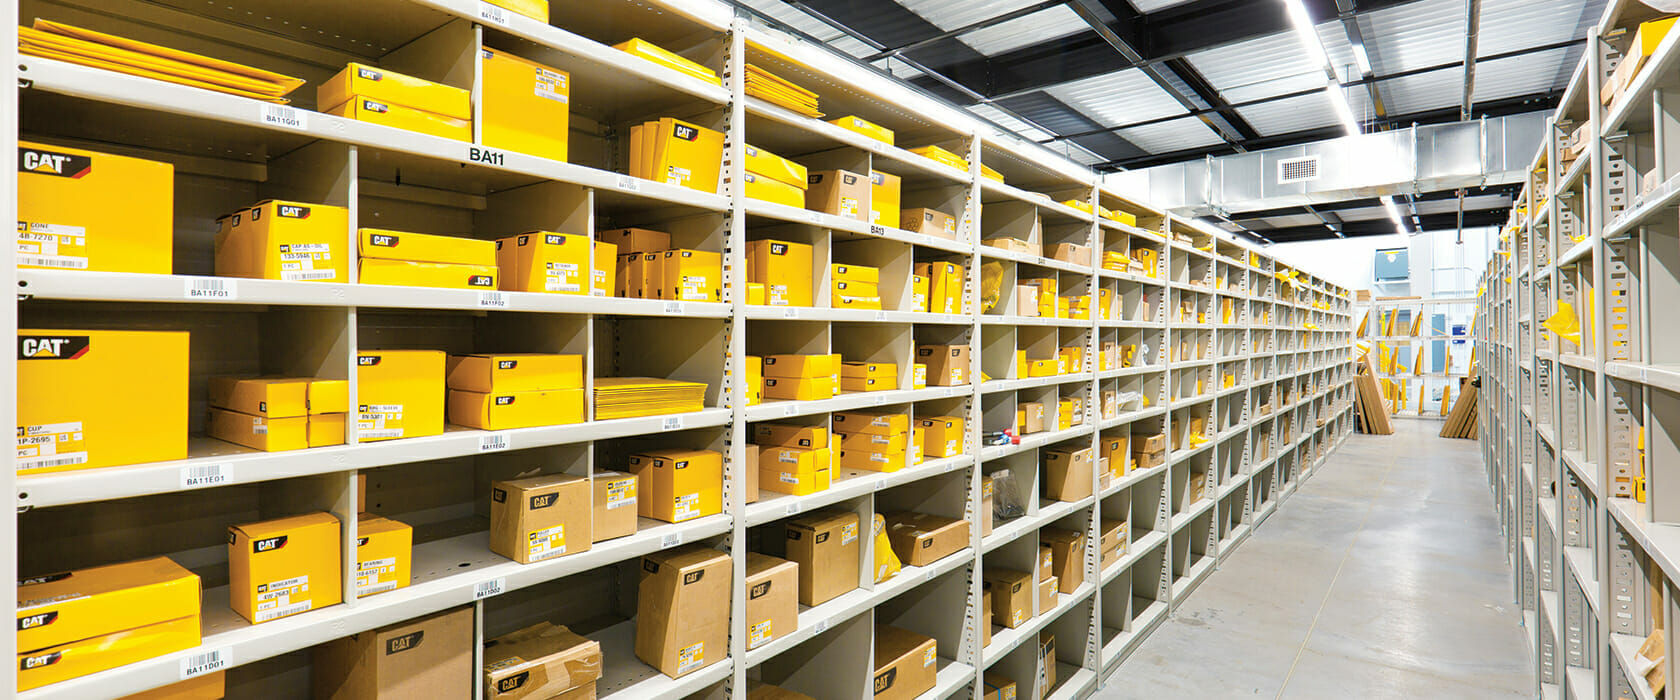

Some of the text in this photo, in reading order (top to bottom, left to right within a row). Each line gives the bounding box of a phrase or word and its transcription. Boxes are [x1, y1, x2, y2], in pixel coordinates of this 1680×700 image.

[360, 70, 376, 80] CAT
[366, 102, 382, 111] CAT
[266, 114, 300, 126] BA11G01
[676, 126, 692, 138] CAT
[469, 147, 504, 166] BA11
[24, 152, 64, 174] CAT
[281, 206, 300, 217] CAT
[870, 225, 884, 236] BA13
[373, 236, 391, 245] CAT
[548, 236, 560, 244] CAT
[474, 277, 490, 285] CAT
[23, 338, 63, 357] CAT
[186, 476, 225, 486] BA11E01
[534, 496, 550, 508] CAT
[258, 539, 279, 551] CAT
[687, 573, 697, 583] CAT
[476, 587, 500, 598] BA11D02
[753, 584, 766, 597] CAT
[22, 614, 46, 629] CAT
[392, 636, 411, 651] CAT
[26, 653, 50, 668] CAT
[186, 660, 224, 676] BA11D01
[503, 676, 519, 690] CAT
[875, 674, 889, 692] CAT
